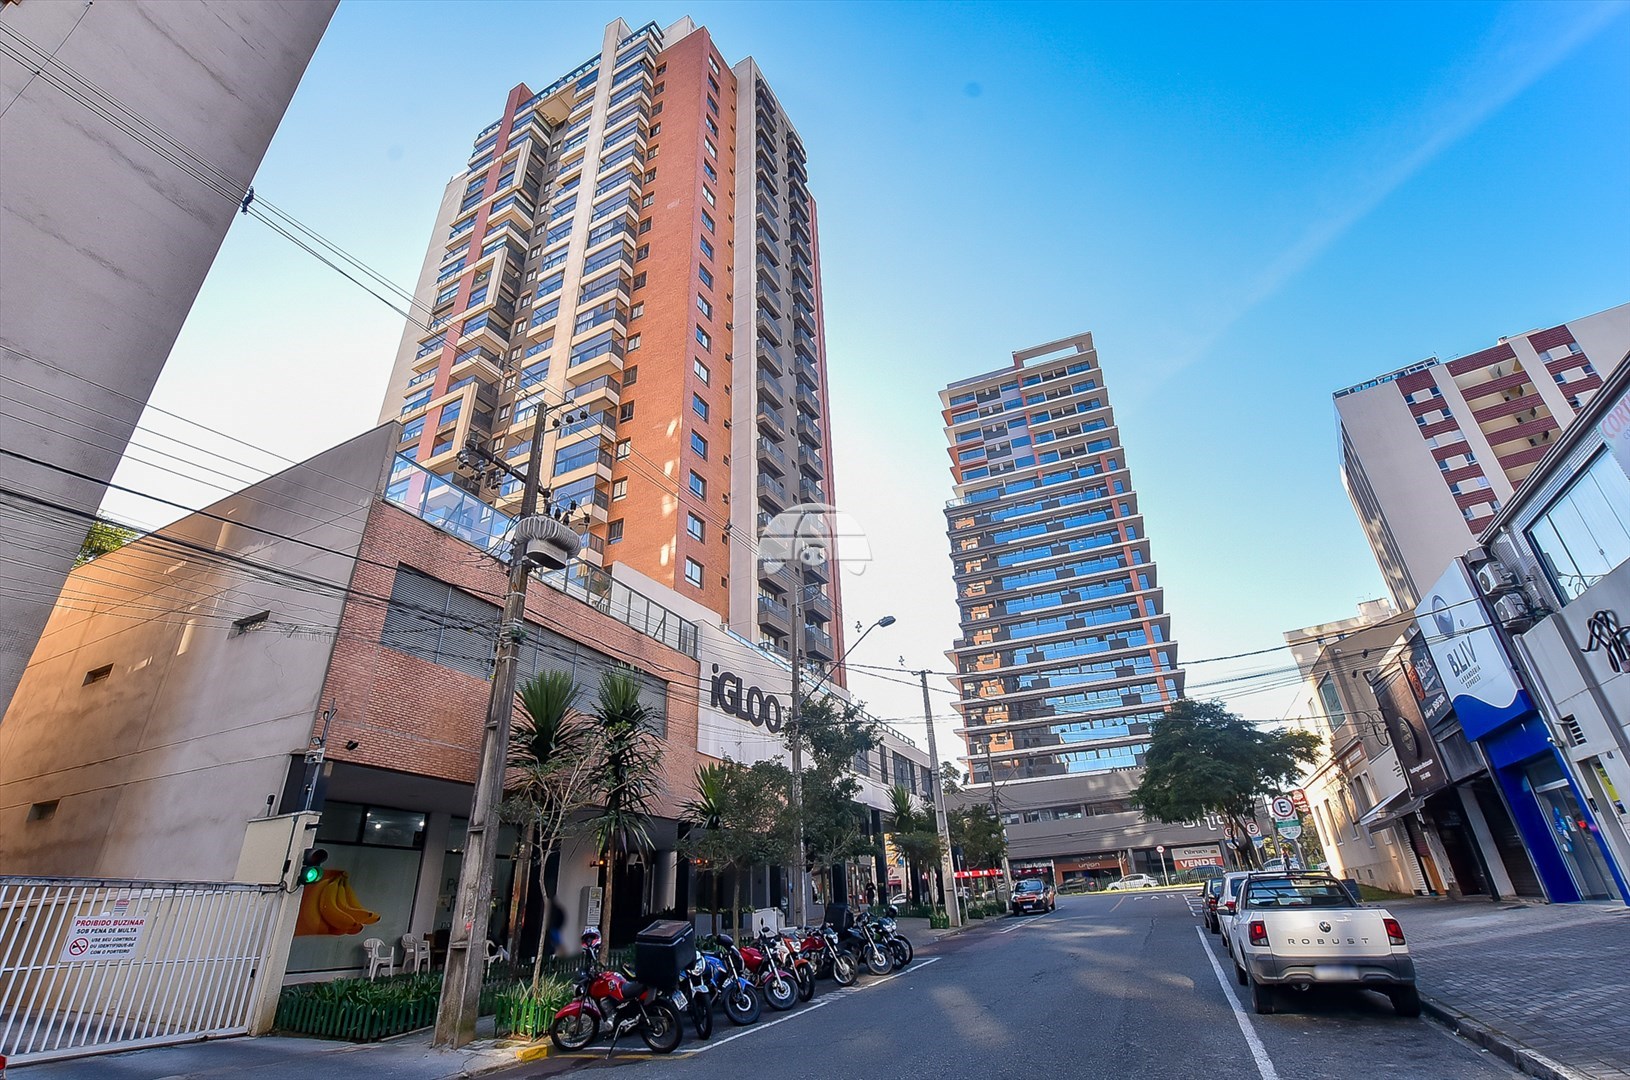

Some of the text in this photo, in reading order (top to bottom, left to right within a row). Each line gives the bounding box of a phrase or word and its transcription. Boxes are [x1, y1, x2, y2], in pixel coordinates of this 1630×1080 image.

[1460, 664, 1481, 685] LAVANDERIA
[1277, 801, 1288, 813] E
[1249, 824, 1256, 832] E
[1180, 857, 1217, 868] VENDE
[1287, 937, 1369, 945] ROBUST
